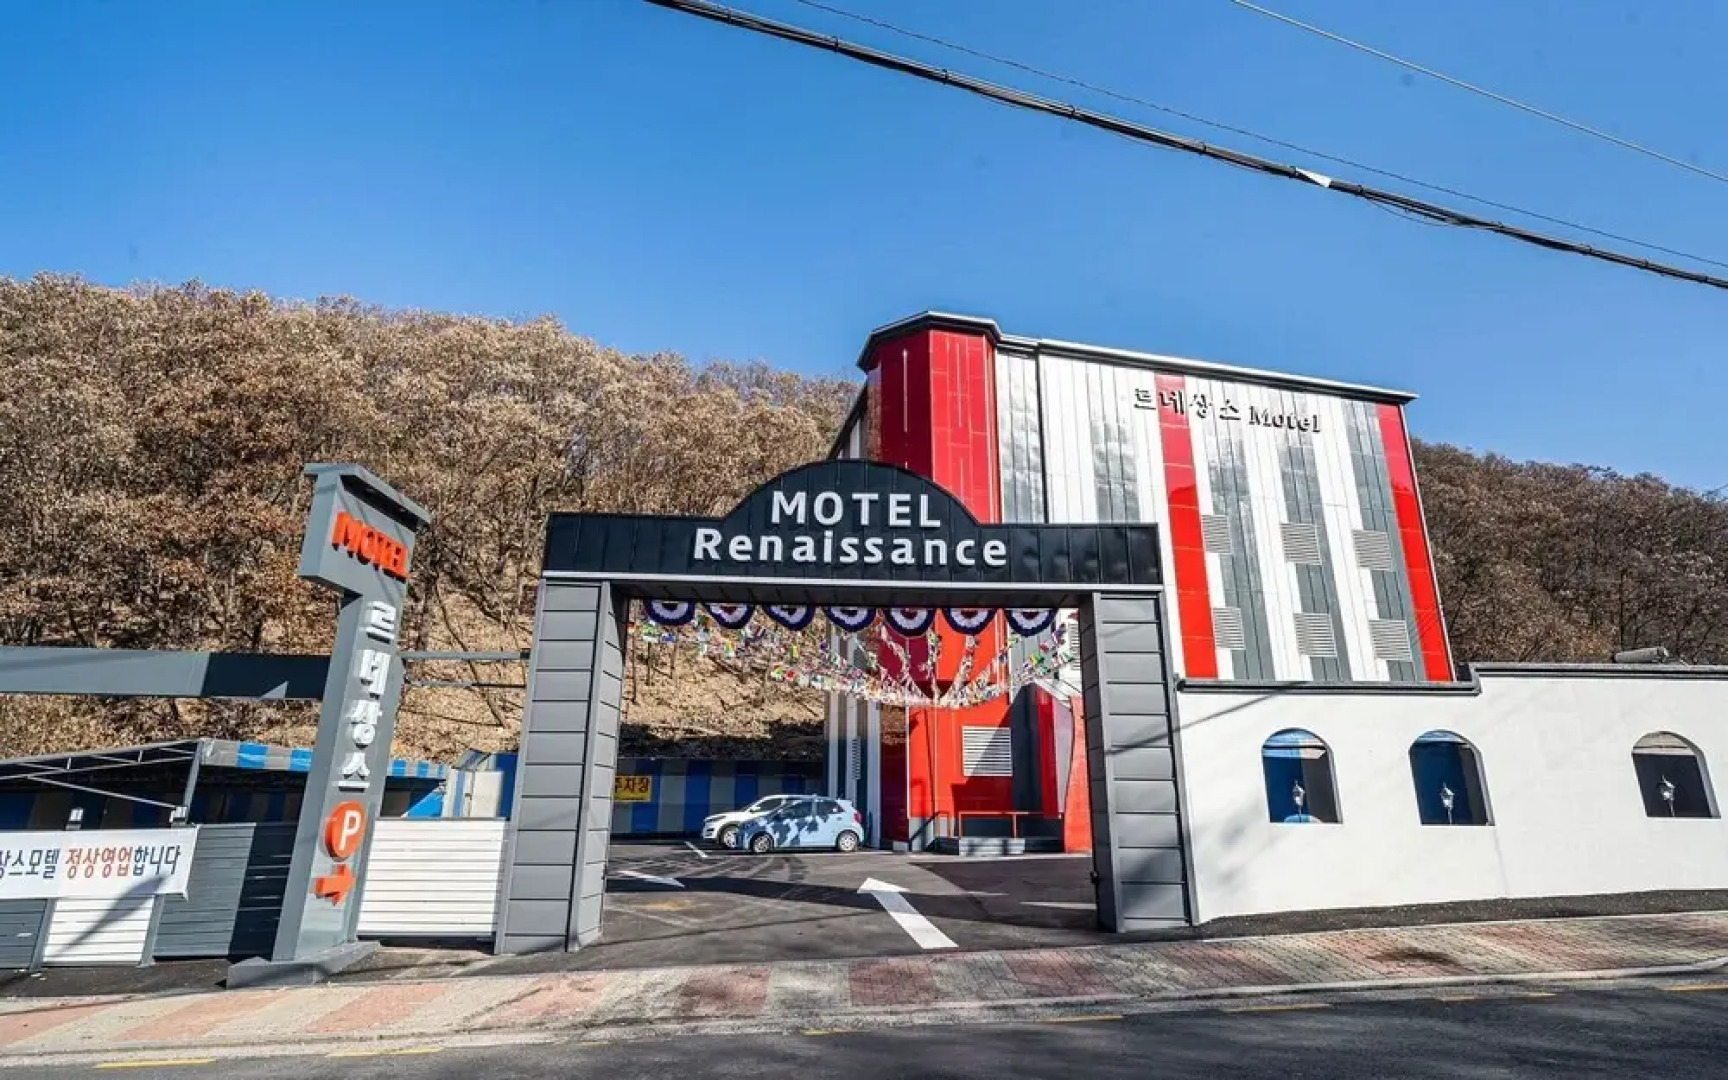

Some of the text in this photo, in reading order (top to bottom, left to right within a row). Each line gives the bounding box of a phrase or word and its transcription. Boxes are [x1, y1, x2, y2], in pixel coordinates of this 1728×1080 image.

[1249, 405, 1321, 433] Motel
[771, 491, 941, 528] MOTEL
[332, 511, 408, 580] MOTEL
[693, 528, 1007, 566] Renaissance
[338, 810, 361, 851] P
[66, 845, 181, 879] 정상영업합니다
